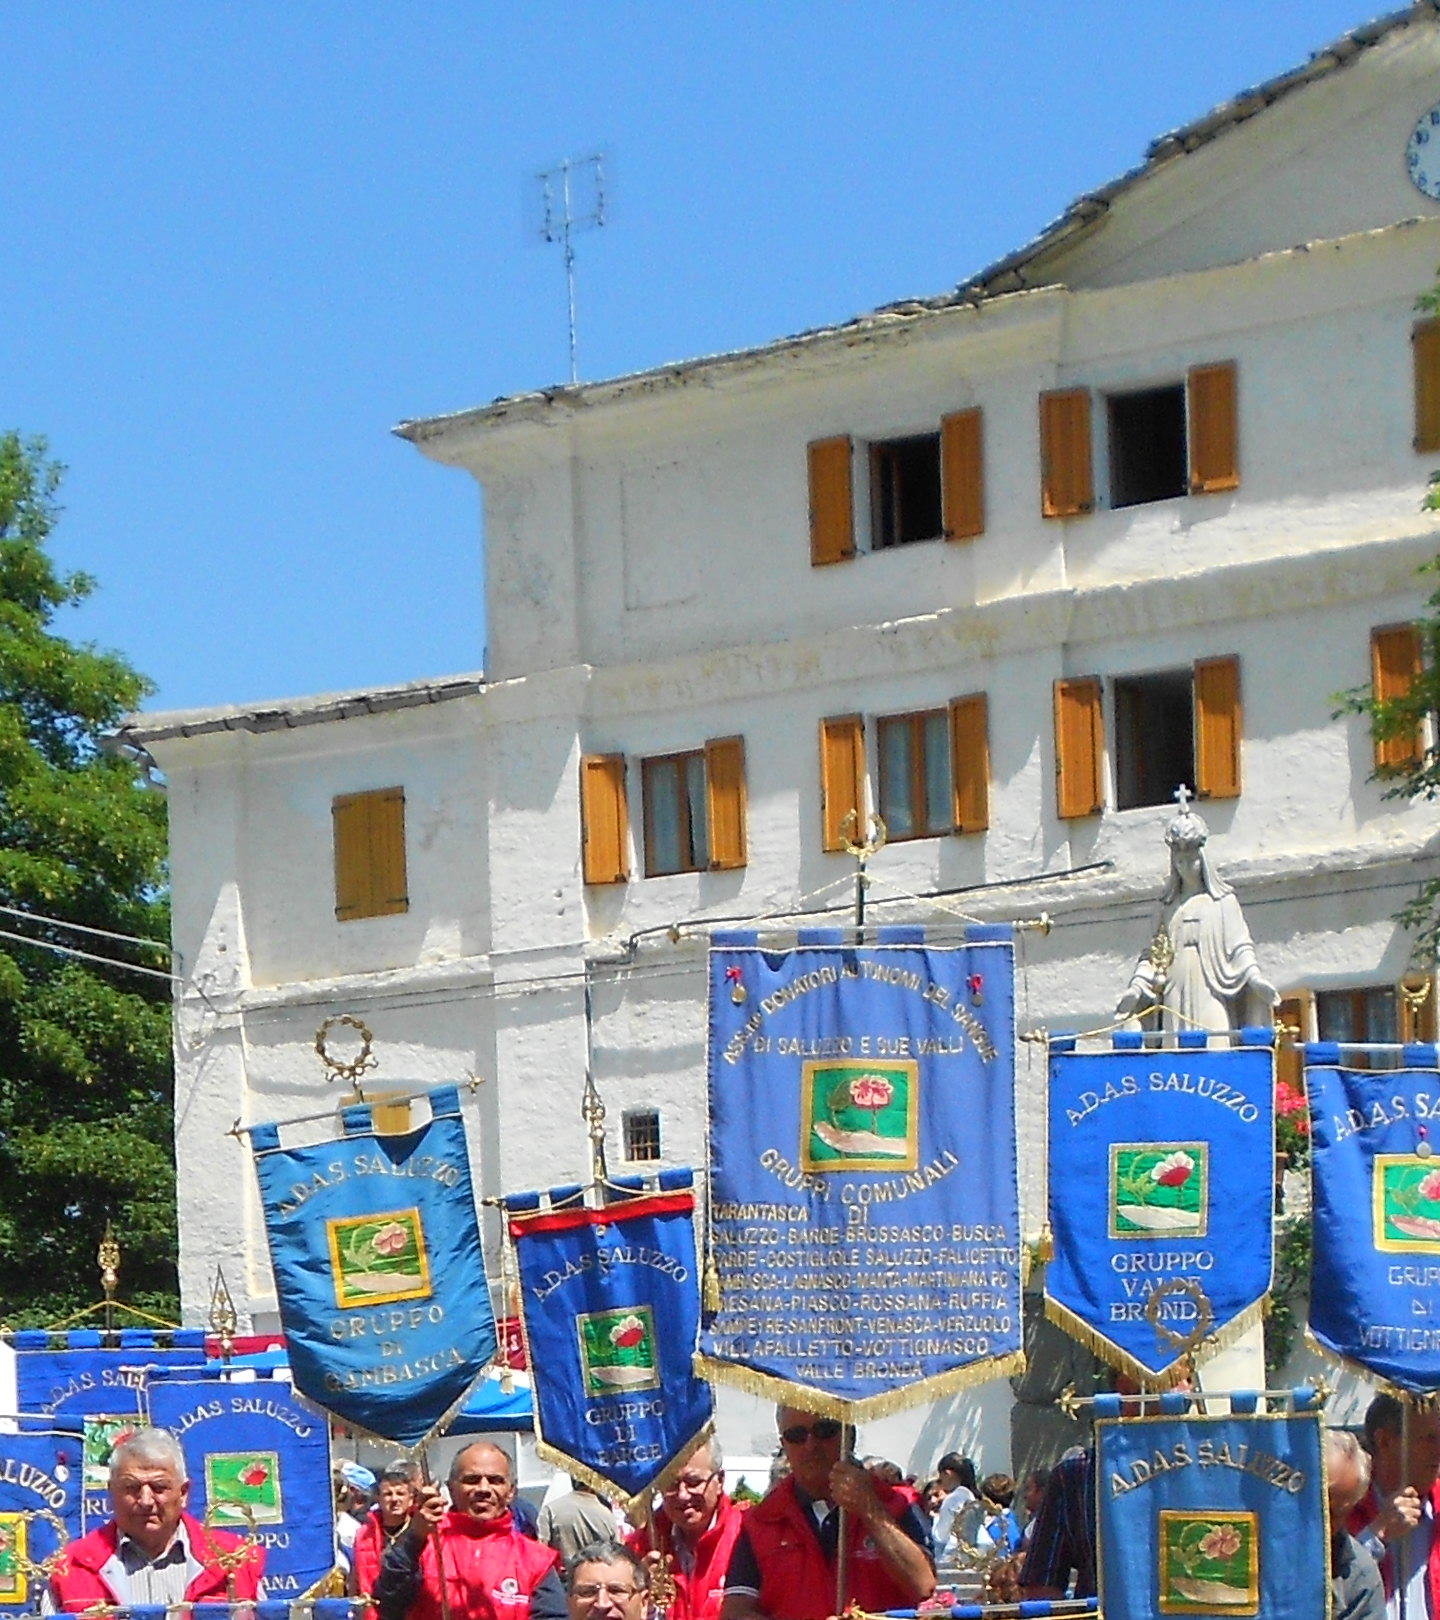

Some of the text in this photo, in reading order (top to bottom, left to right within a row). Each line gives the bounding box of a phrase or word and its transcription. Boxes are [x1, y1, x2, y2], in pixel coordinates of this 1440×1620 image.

[760, 966, 839, 1015] DONATORI
[922, 981, 951, 1010] DEL
[951, 1003, 999, 1064] SANGUE
[754, 1036, 772, 1053] DI
[861, 1036, 871, 1054] E
[877, 1036, 910, 1055] SUE
[1064, 1072, 1260, 1128] A.D.A.S. SALUZZO
[760, 1148, 961, 1204] GRUPPI COMUNALI
[848, 1204, 869, 1225] DI
[597, 1247, 690, 1285] SALUZZO
[1110, 1250, 1215, 1273] GRUPPO
[328, 1304, 446, 1341] GRUPPO
[796, 1361, 924, 1380] VALLE BRONDA
[231, 1397, 311, 1439] SALUZZO
[584, 1399, 665, 1426] GRUPPO
